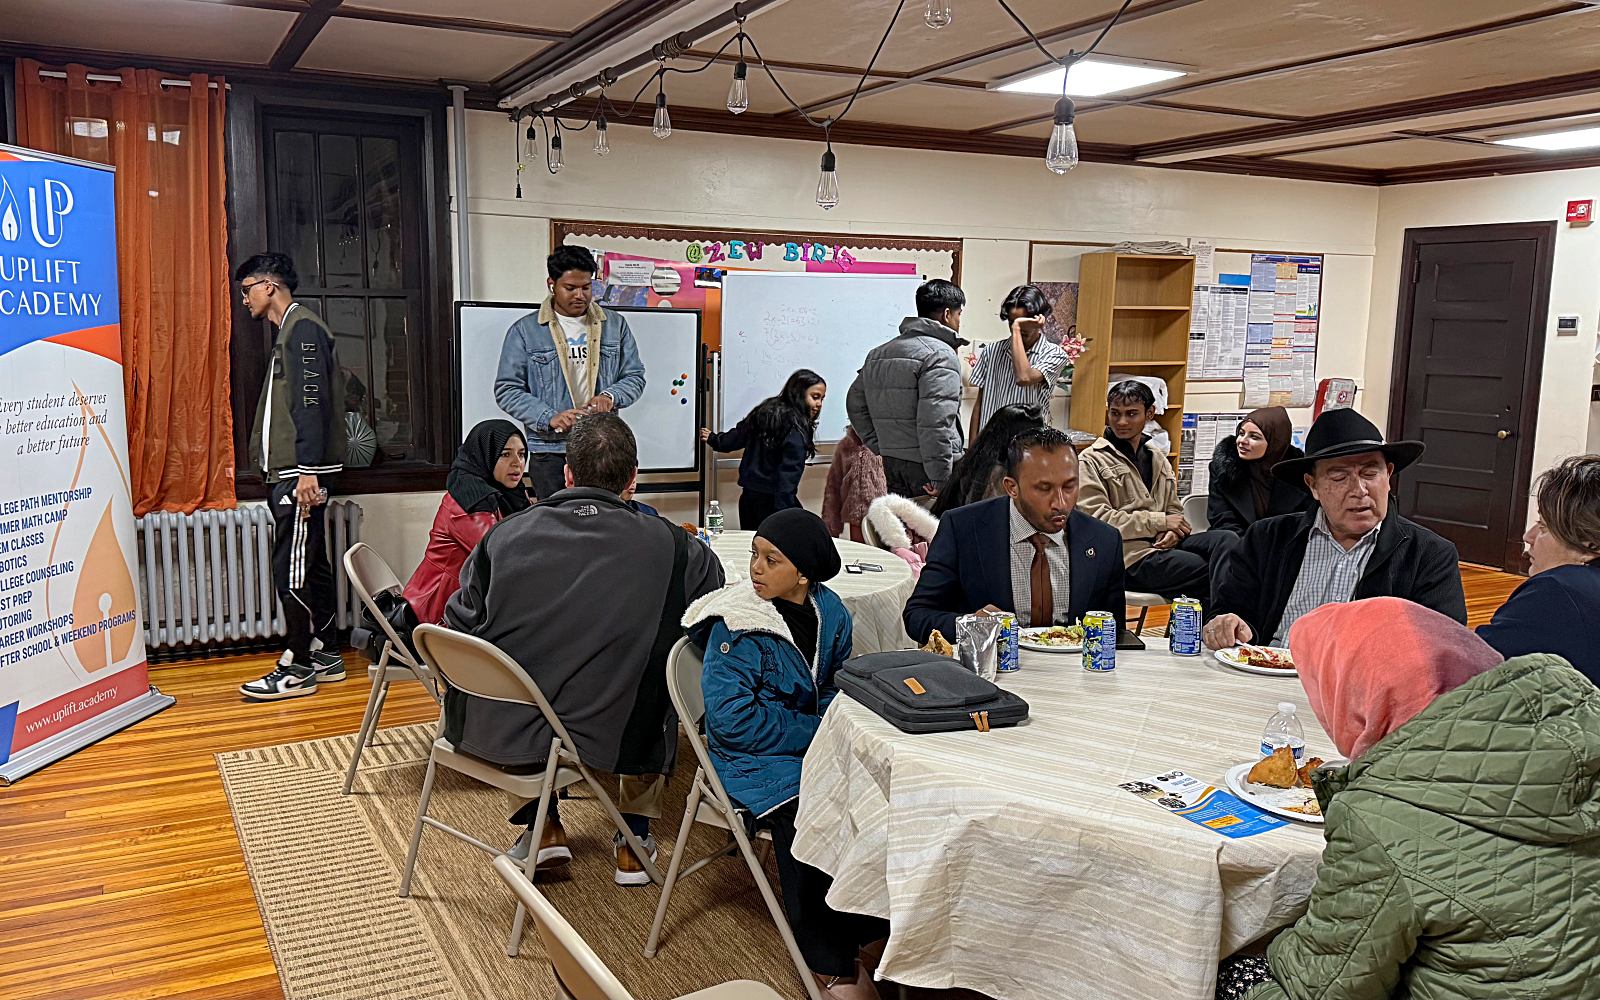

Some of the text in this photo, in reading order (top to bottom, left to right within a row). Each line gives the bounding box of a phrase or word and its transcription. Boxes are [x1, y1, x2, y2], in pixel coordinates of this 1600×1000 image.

[0, 256, 81, 284] UPLIFT
[0, 290, 101, 316] CADEMY
[568, 347, 587, 359] LIS
[301, 342, 320, 407] BLACK
[26, 393, 65, 411] student
[68, 391, 107, 407] deserves
[6, 409, 108, 435] better education and
[17, 434, 90, 455] a better future
[0, 487, 92, 516] LEGE PATH MENTORSHIP
[21, 513, 43, 530] MATH
[44, 509, 68, 524] CAMP
[11, 532, 45, 551] CLASSES
[0, 555, 27, 573] BOTICS
[0, 561, 74, 592] LLEGE COUNSELING
[0, 590, 33, 611] ST PREP
[0, 613, 74, 649] AREER WORKSHOPS
[0, 609, 136, 668] FTER SCHOOL & WEEKEND PROGRAMS
[25, 685, 118, 733] www.uplift.academy
